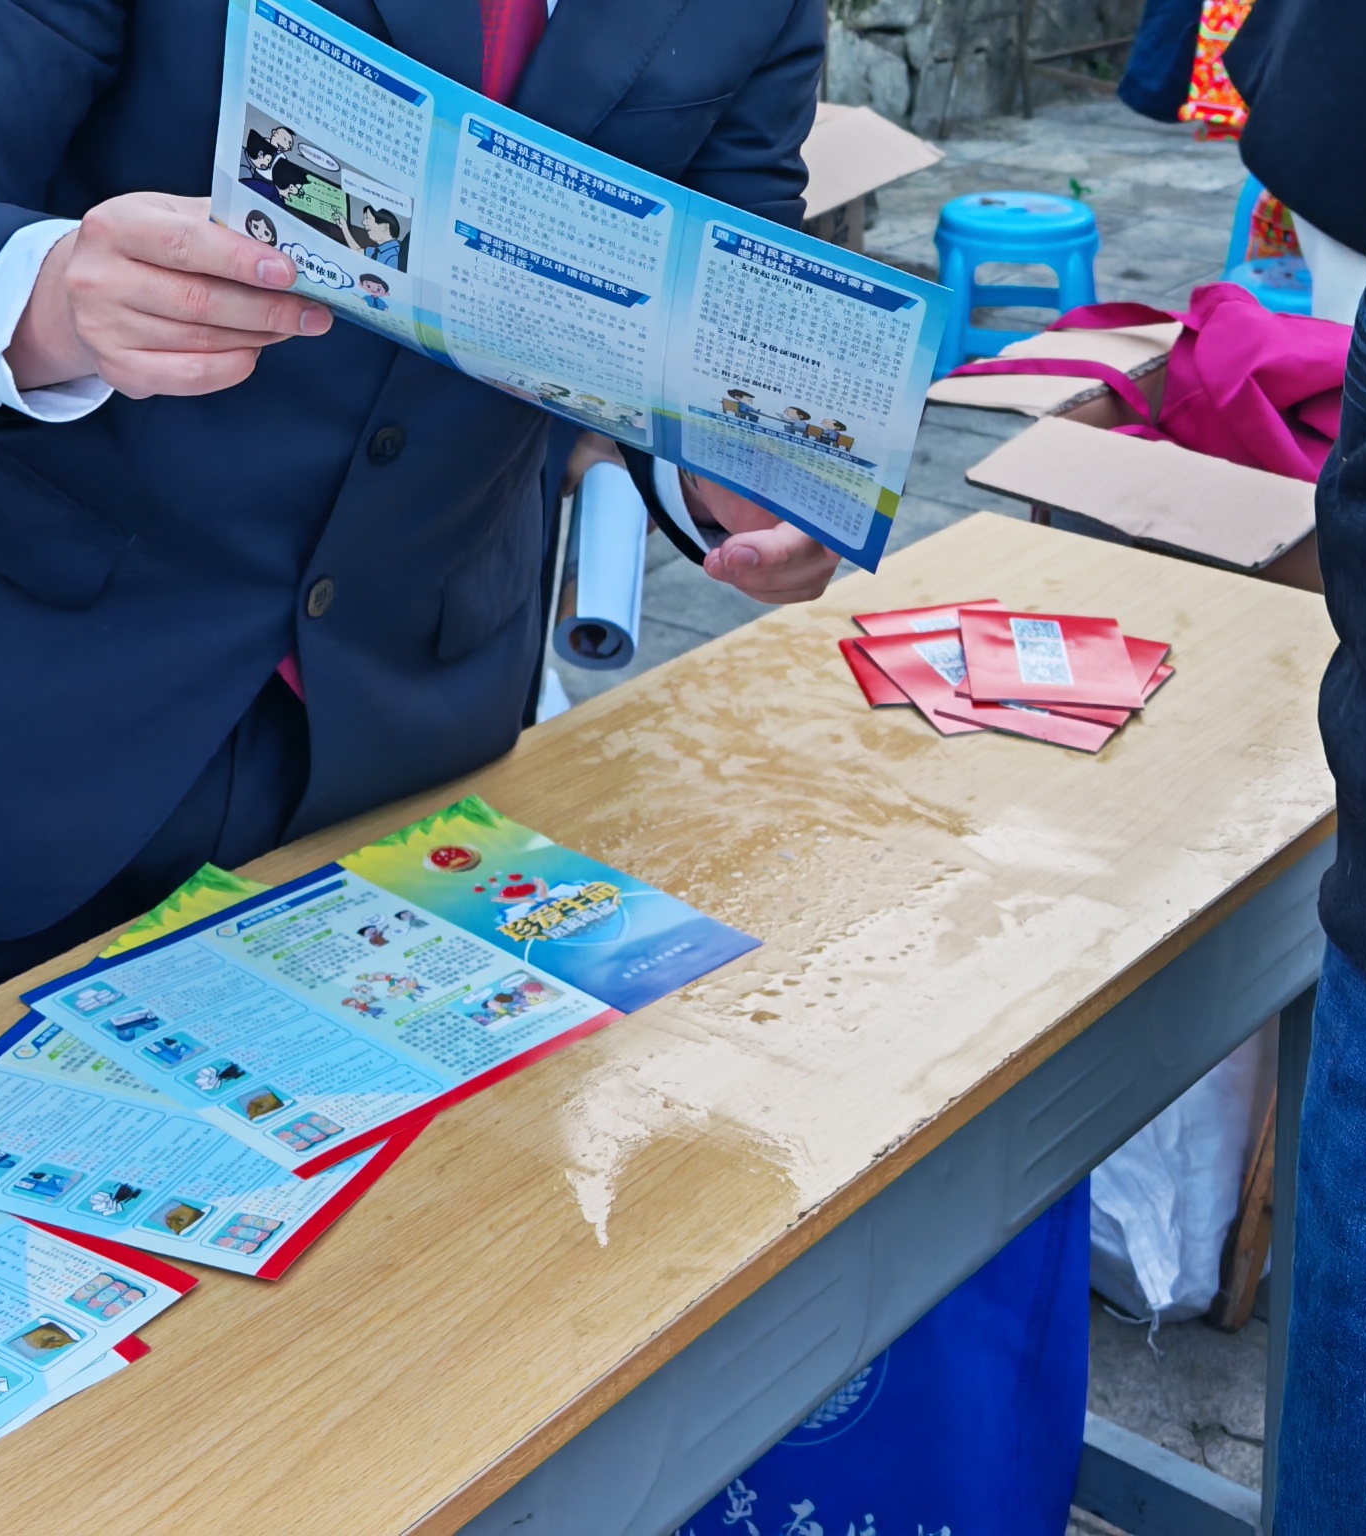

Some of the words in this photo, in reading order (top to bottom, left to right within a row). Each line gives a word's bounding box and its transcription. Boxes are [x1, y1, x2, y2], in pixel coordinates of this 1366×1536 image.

[277, 15, 379, 82] 民事支持起诉是什么？
[491, 143, 597, 200] 的工作原则是什么？
[493, 131, 643, 207] 检察机关在民事支持起诉中
[477, 242, 534, 272] 支持起诉？
[479, 232, 629, 298] 哪些情形可以申请检察机关
[737, 247, 798, 277] 哪些材料？
[740, 237, 874, 294] 申请民事支持起诉需要
